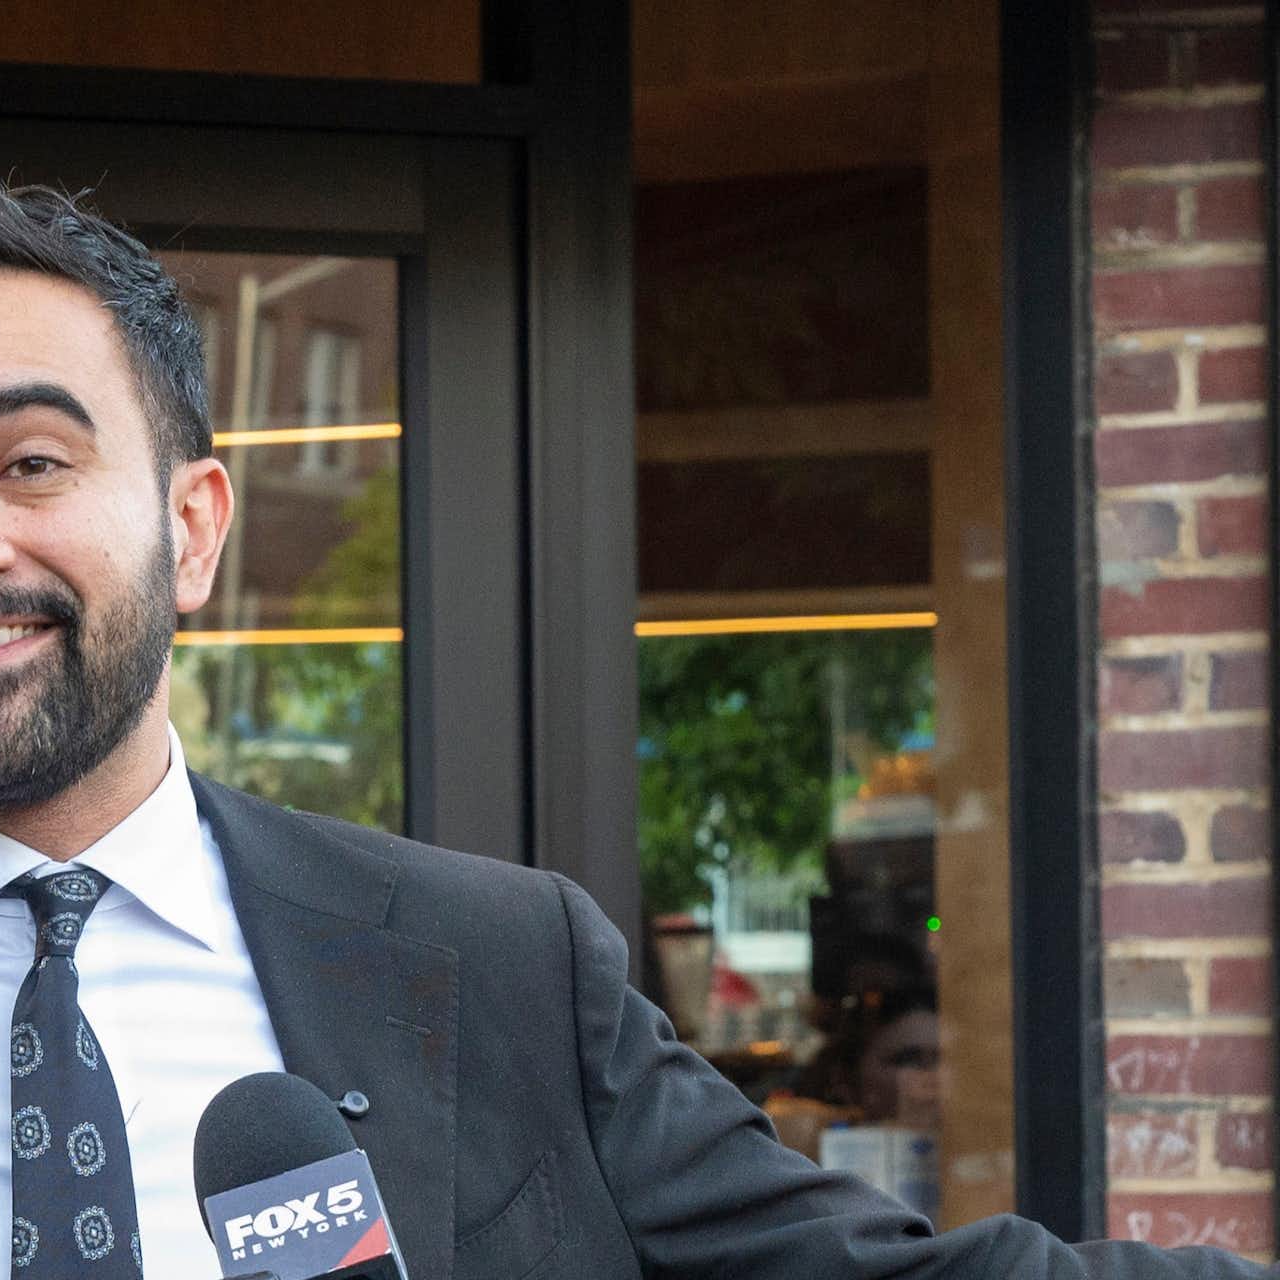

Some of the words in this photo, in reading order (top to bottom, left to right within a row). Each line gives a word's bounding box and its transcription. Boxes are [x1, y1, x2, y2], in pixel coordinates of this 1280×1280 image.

[225, 1192, 326, 1249] FOX
[327, 1180, 363, 1214] 5
[232, 1236, 285, 1260] NEW
[299, 1210, 367, 1239] YORK
